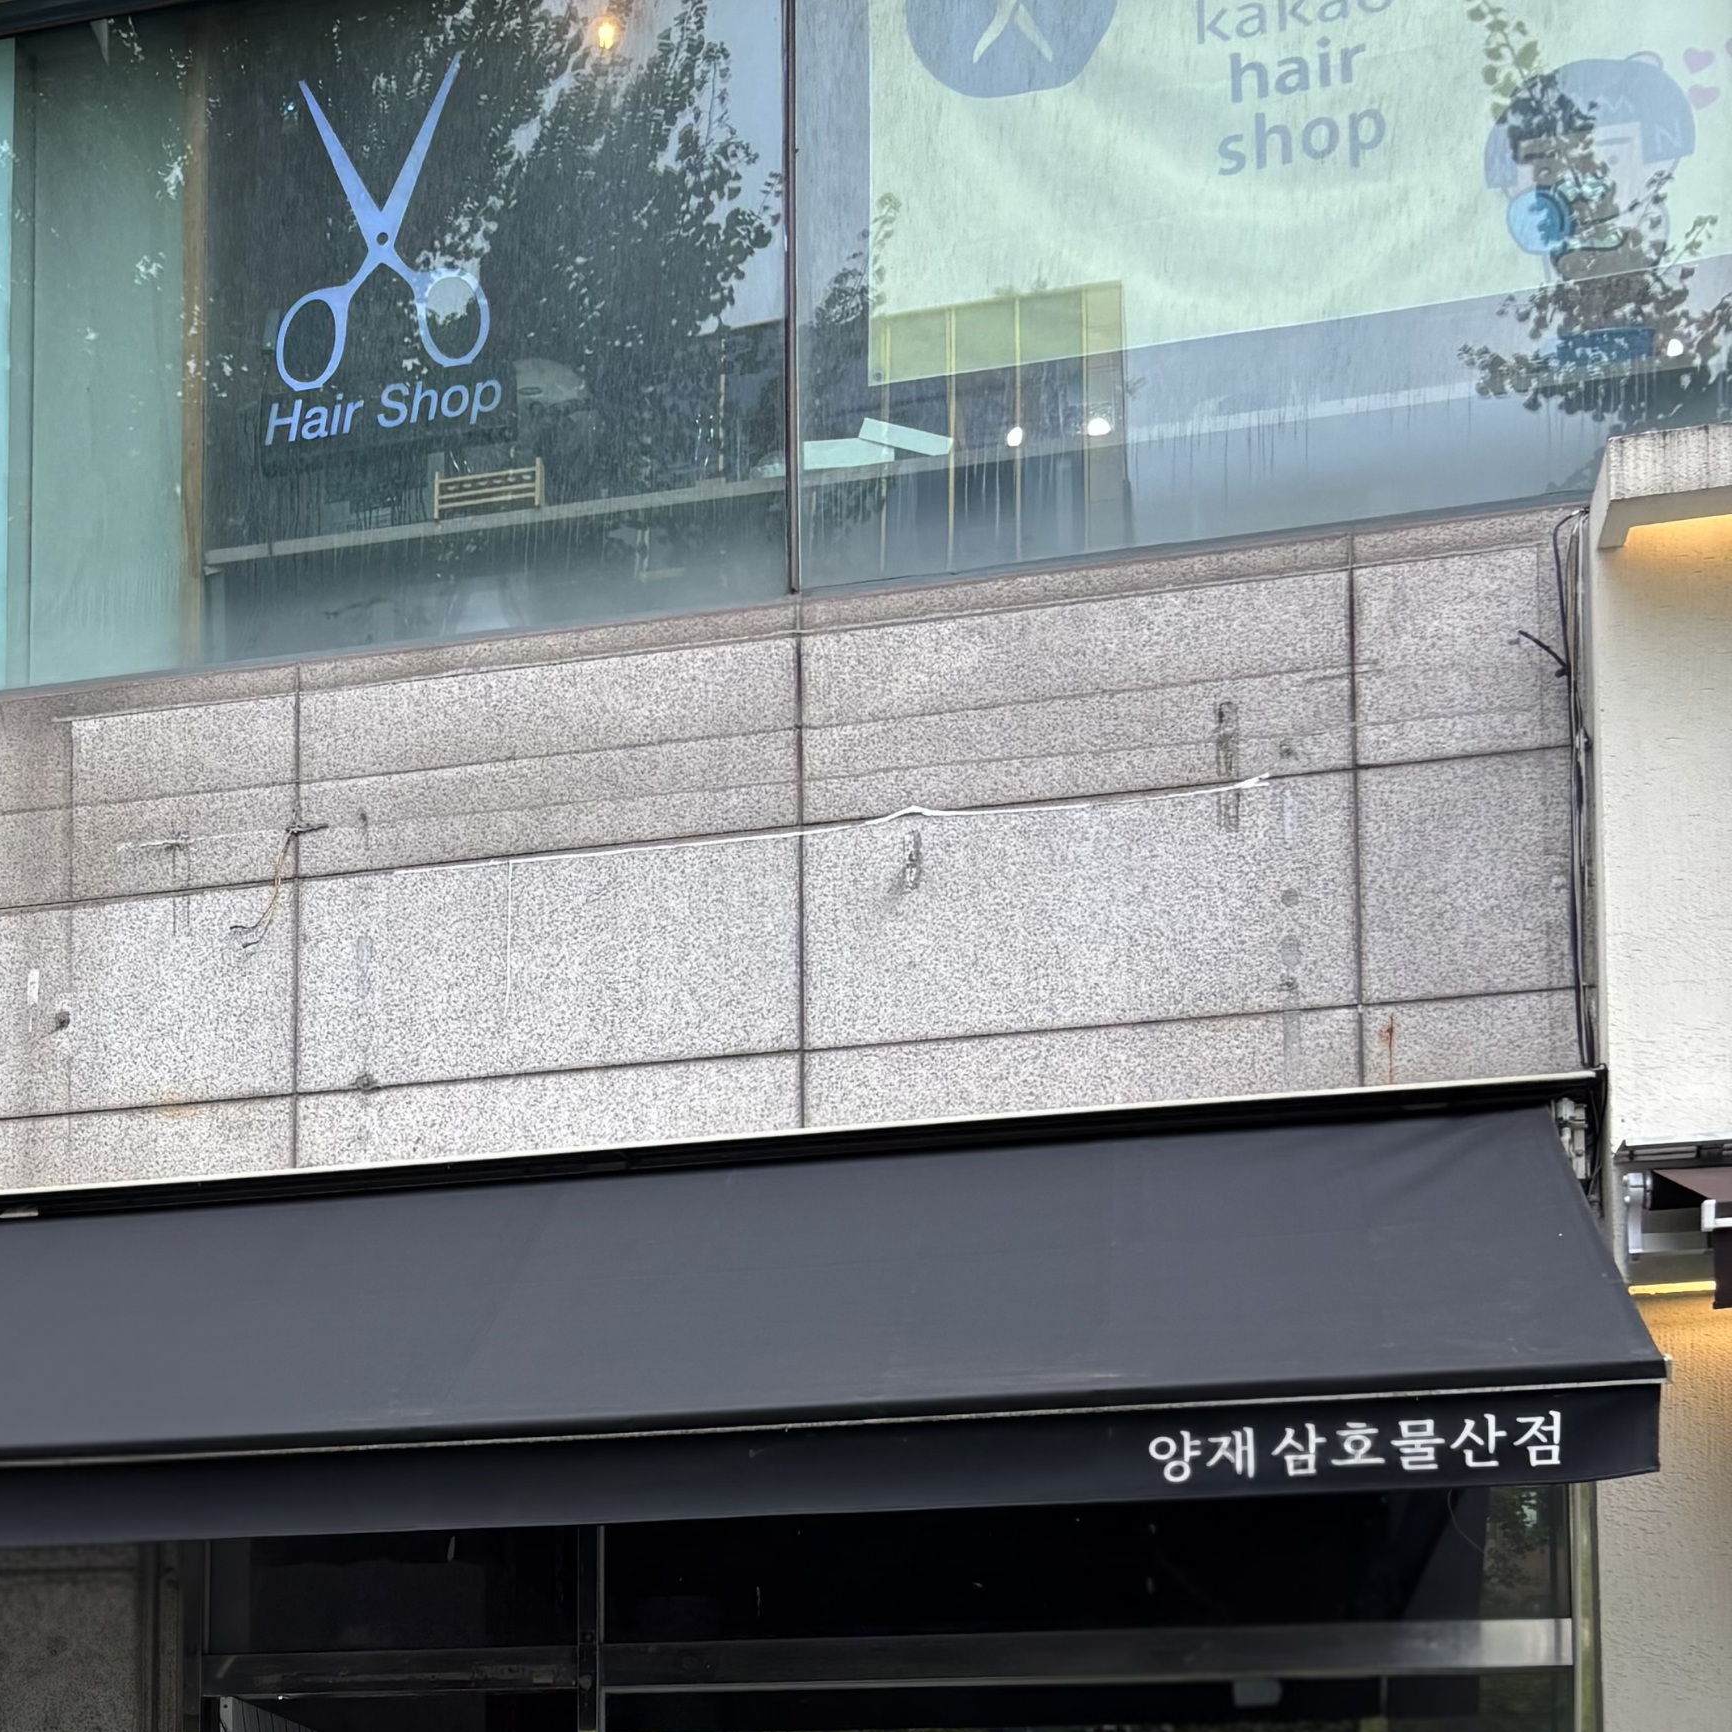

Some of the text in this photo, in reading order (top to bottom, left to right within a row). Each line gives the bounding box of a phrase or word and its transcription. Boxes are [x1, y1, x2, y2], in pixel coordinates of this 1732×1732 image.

[1229, 36, 1366, 103] hair
[1218, 108, 1386, 175] shop
[265, 379, 502, 445] Hair Shop
[1148, 1410, 1562, 1483] 양재 삼호물산점
